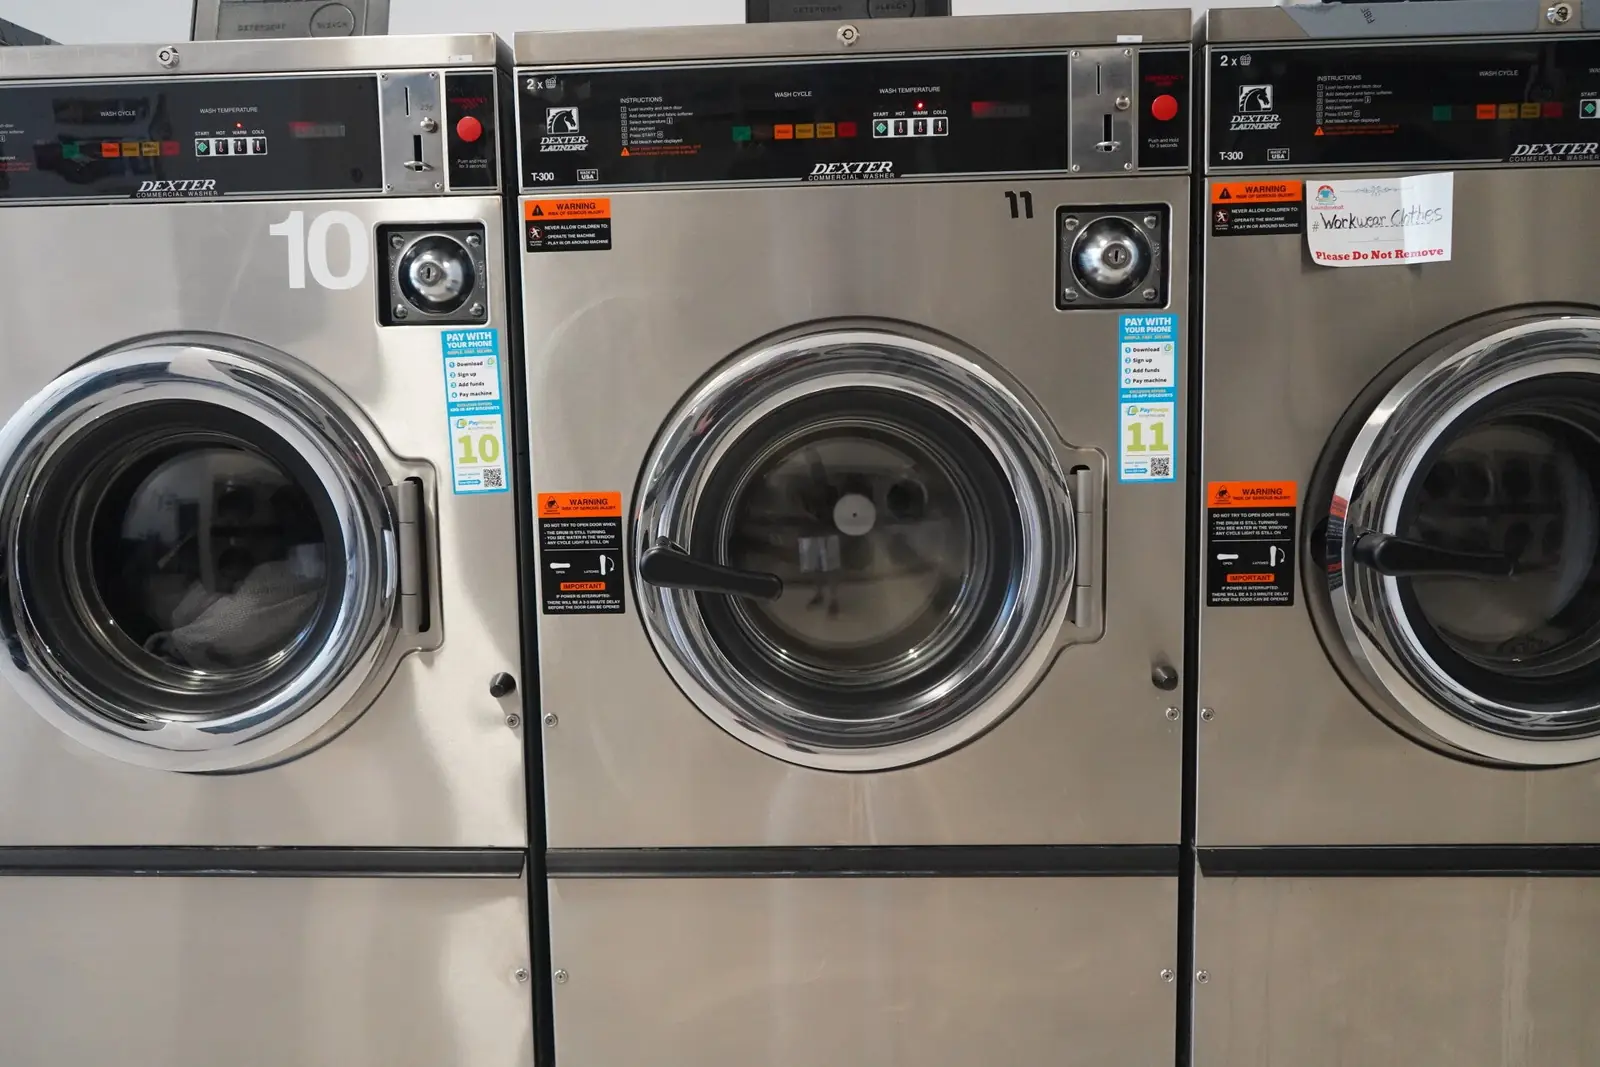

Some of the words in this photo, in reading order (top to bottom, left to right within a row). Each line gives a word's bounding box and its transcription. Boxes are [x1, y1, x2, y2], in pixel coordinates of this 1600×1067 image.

[1220, 56, 1228, 66] 2
[526, 78, 535, 90] 2
[537, 80, 544, 89] x
[1230, 114, 1279, 123] DEXTER
[1230, 122, 1280, 131] LAUNDRY
[540, 136, 587, 144] DEXTER
[540, 144, 588, 152] LAUNDRY
[1511, 142, 1599, 156] DEXTER
[1219, 152, 1243, 160] T-300
[810, 162, 894, 174] DEXTER
[531, 172, 554, 181] T-300
[138, 179, 216, 192] DEXTER
[1245, 185, 1286, 193] WARNING
[1004, 190, 1034, 219] 11
[1320, 212, 1386, 230] Workwear
[269, 210, 369, 290] 10
[1316, 251, 1350, 261] Please
[1352, 251, 1368, 260] Do
[1371, 250, 1392, 260] Not
[1395, 248, 1444, 259] Remove
[1125, 318, 1143, 326] PAY
[1145, 317, 1171, 326] WITH
[446, 333, 465, 342] PAY
[466, 332, 492, 340] WITH
[1127, 422, 1168, 452] 11
[458, 434, 499, 464] 10
